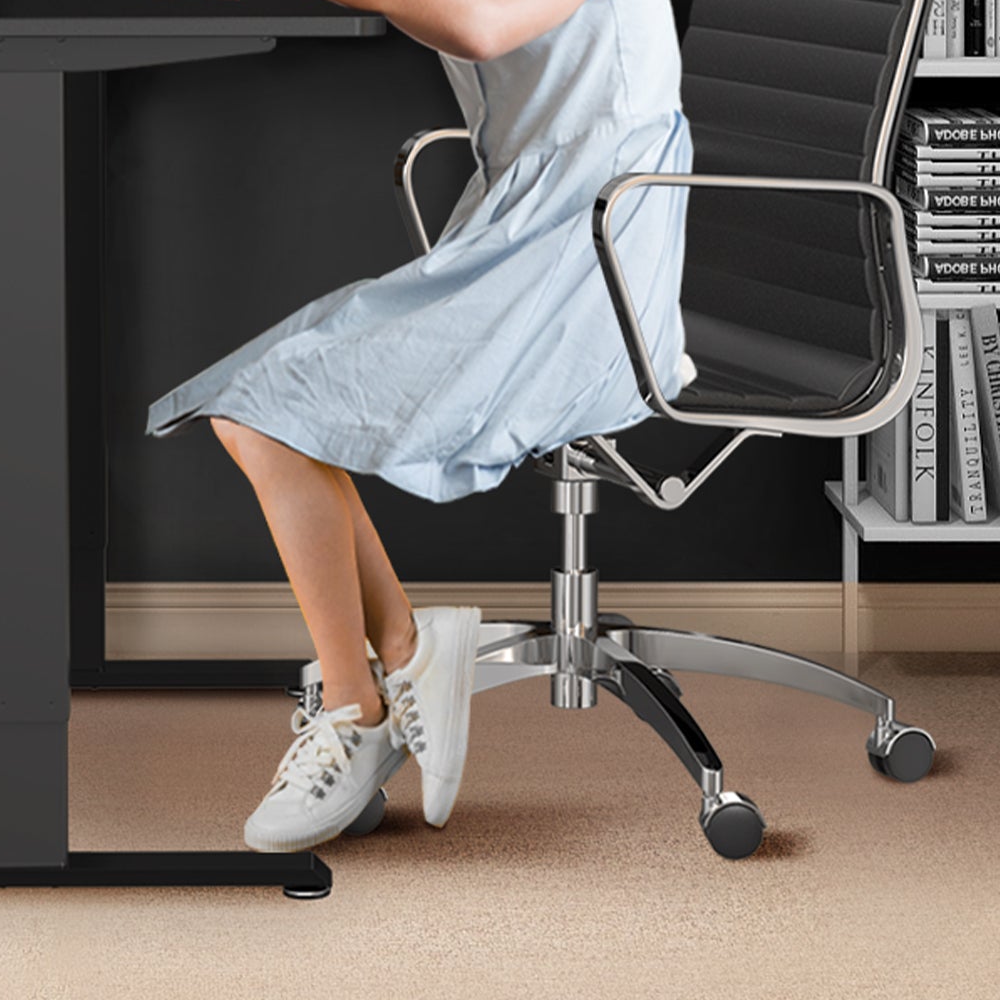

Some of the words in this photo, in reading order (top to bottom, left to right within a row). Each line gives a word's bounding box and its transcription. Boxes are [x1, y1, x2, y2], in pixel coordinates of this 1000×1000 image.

[959, 346, 969, 367] LEE
[981, 334, 999, 355] BY
[915, 346, 935, 482] KINFOLK
[960, 388, 984, 514] TRANQUILITY
